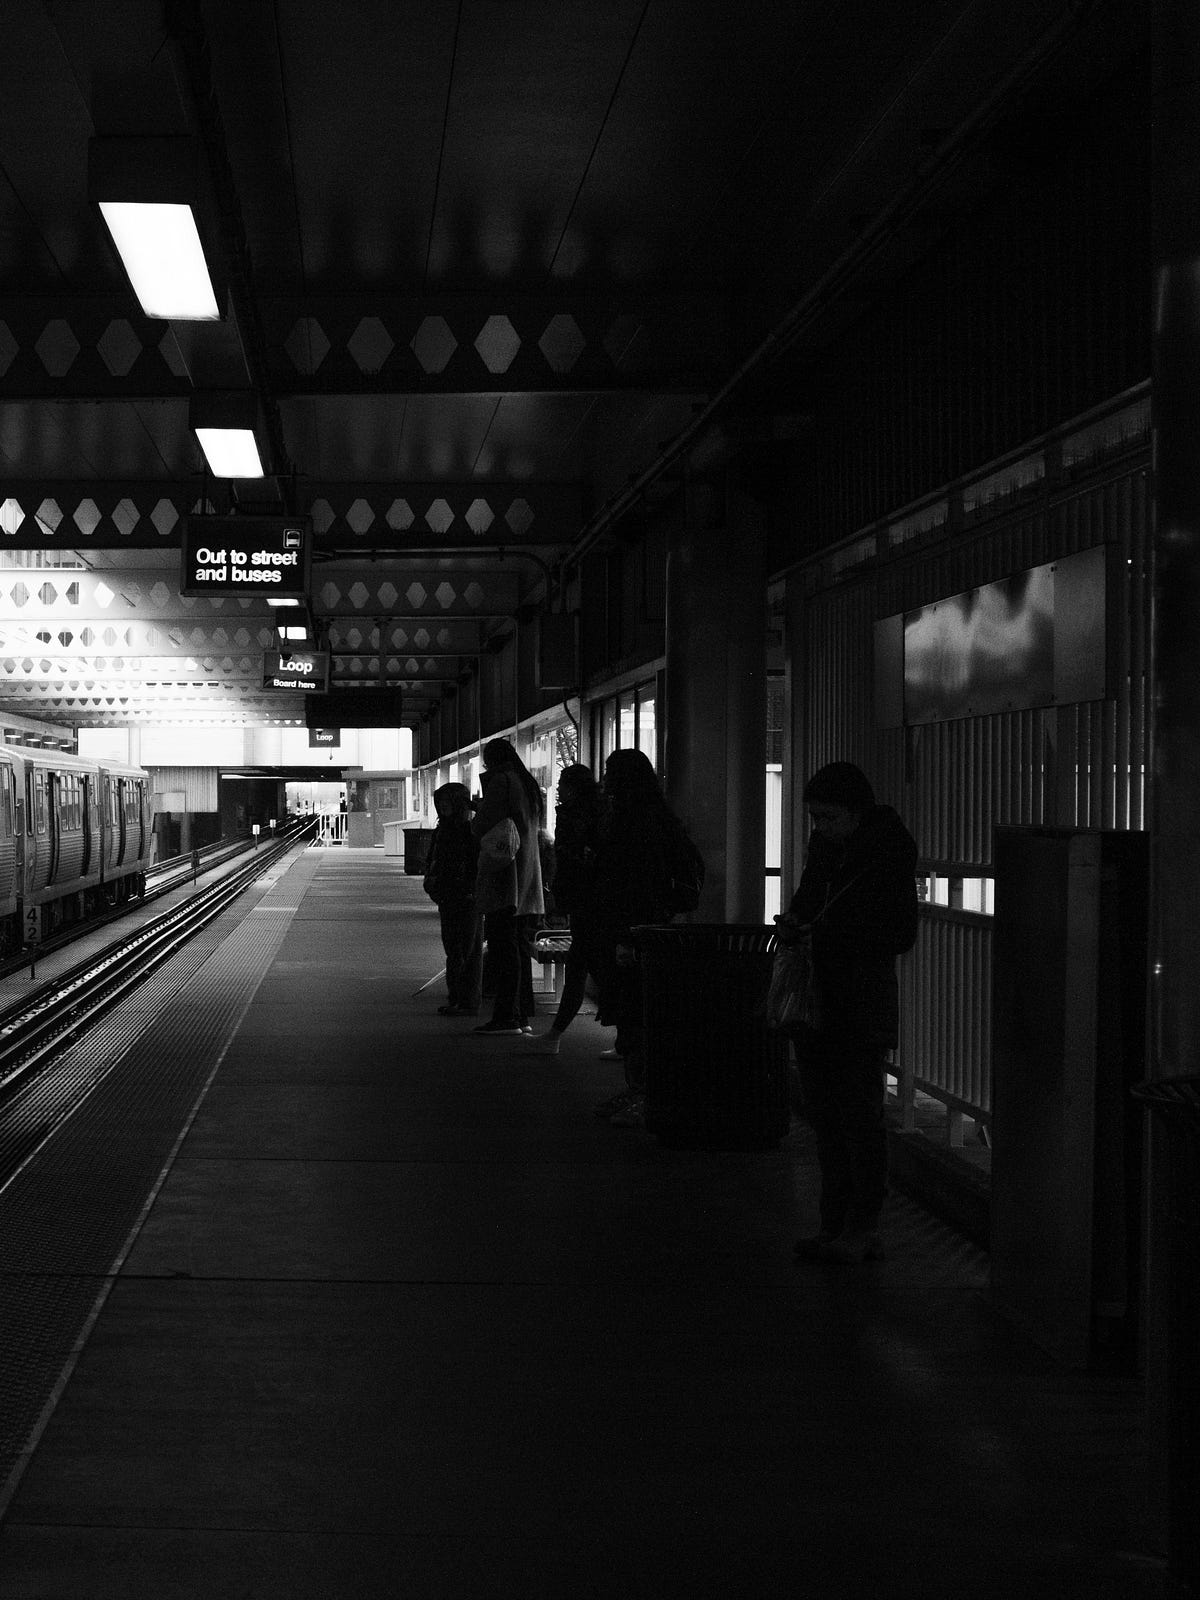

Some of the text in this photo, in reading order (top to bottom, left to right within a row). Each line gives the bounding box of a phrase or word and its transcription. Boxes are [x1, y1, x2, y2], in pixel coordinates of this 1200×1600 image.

[196, 548, 298, 566] Out to street
[196, 566, 282, 583] and buses
[279, 658, 313, 675] Loop
[273, 679, 316, 689] Board here
[316, 734, 334, 742] Loop
[27, 908, 38, 922] 4
[28, 927, 37, 940] 2
